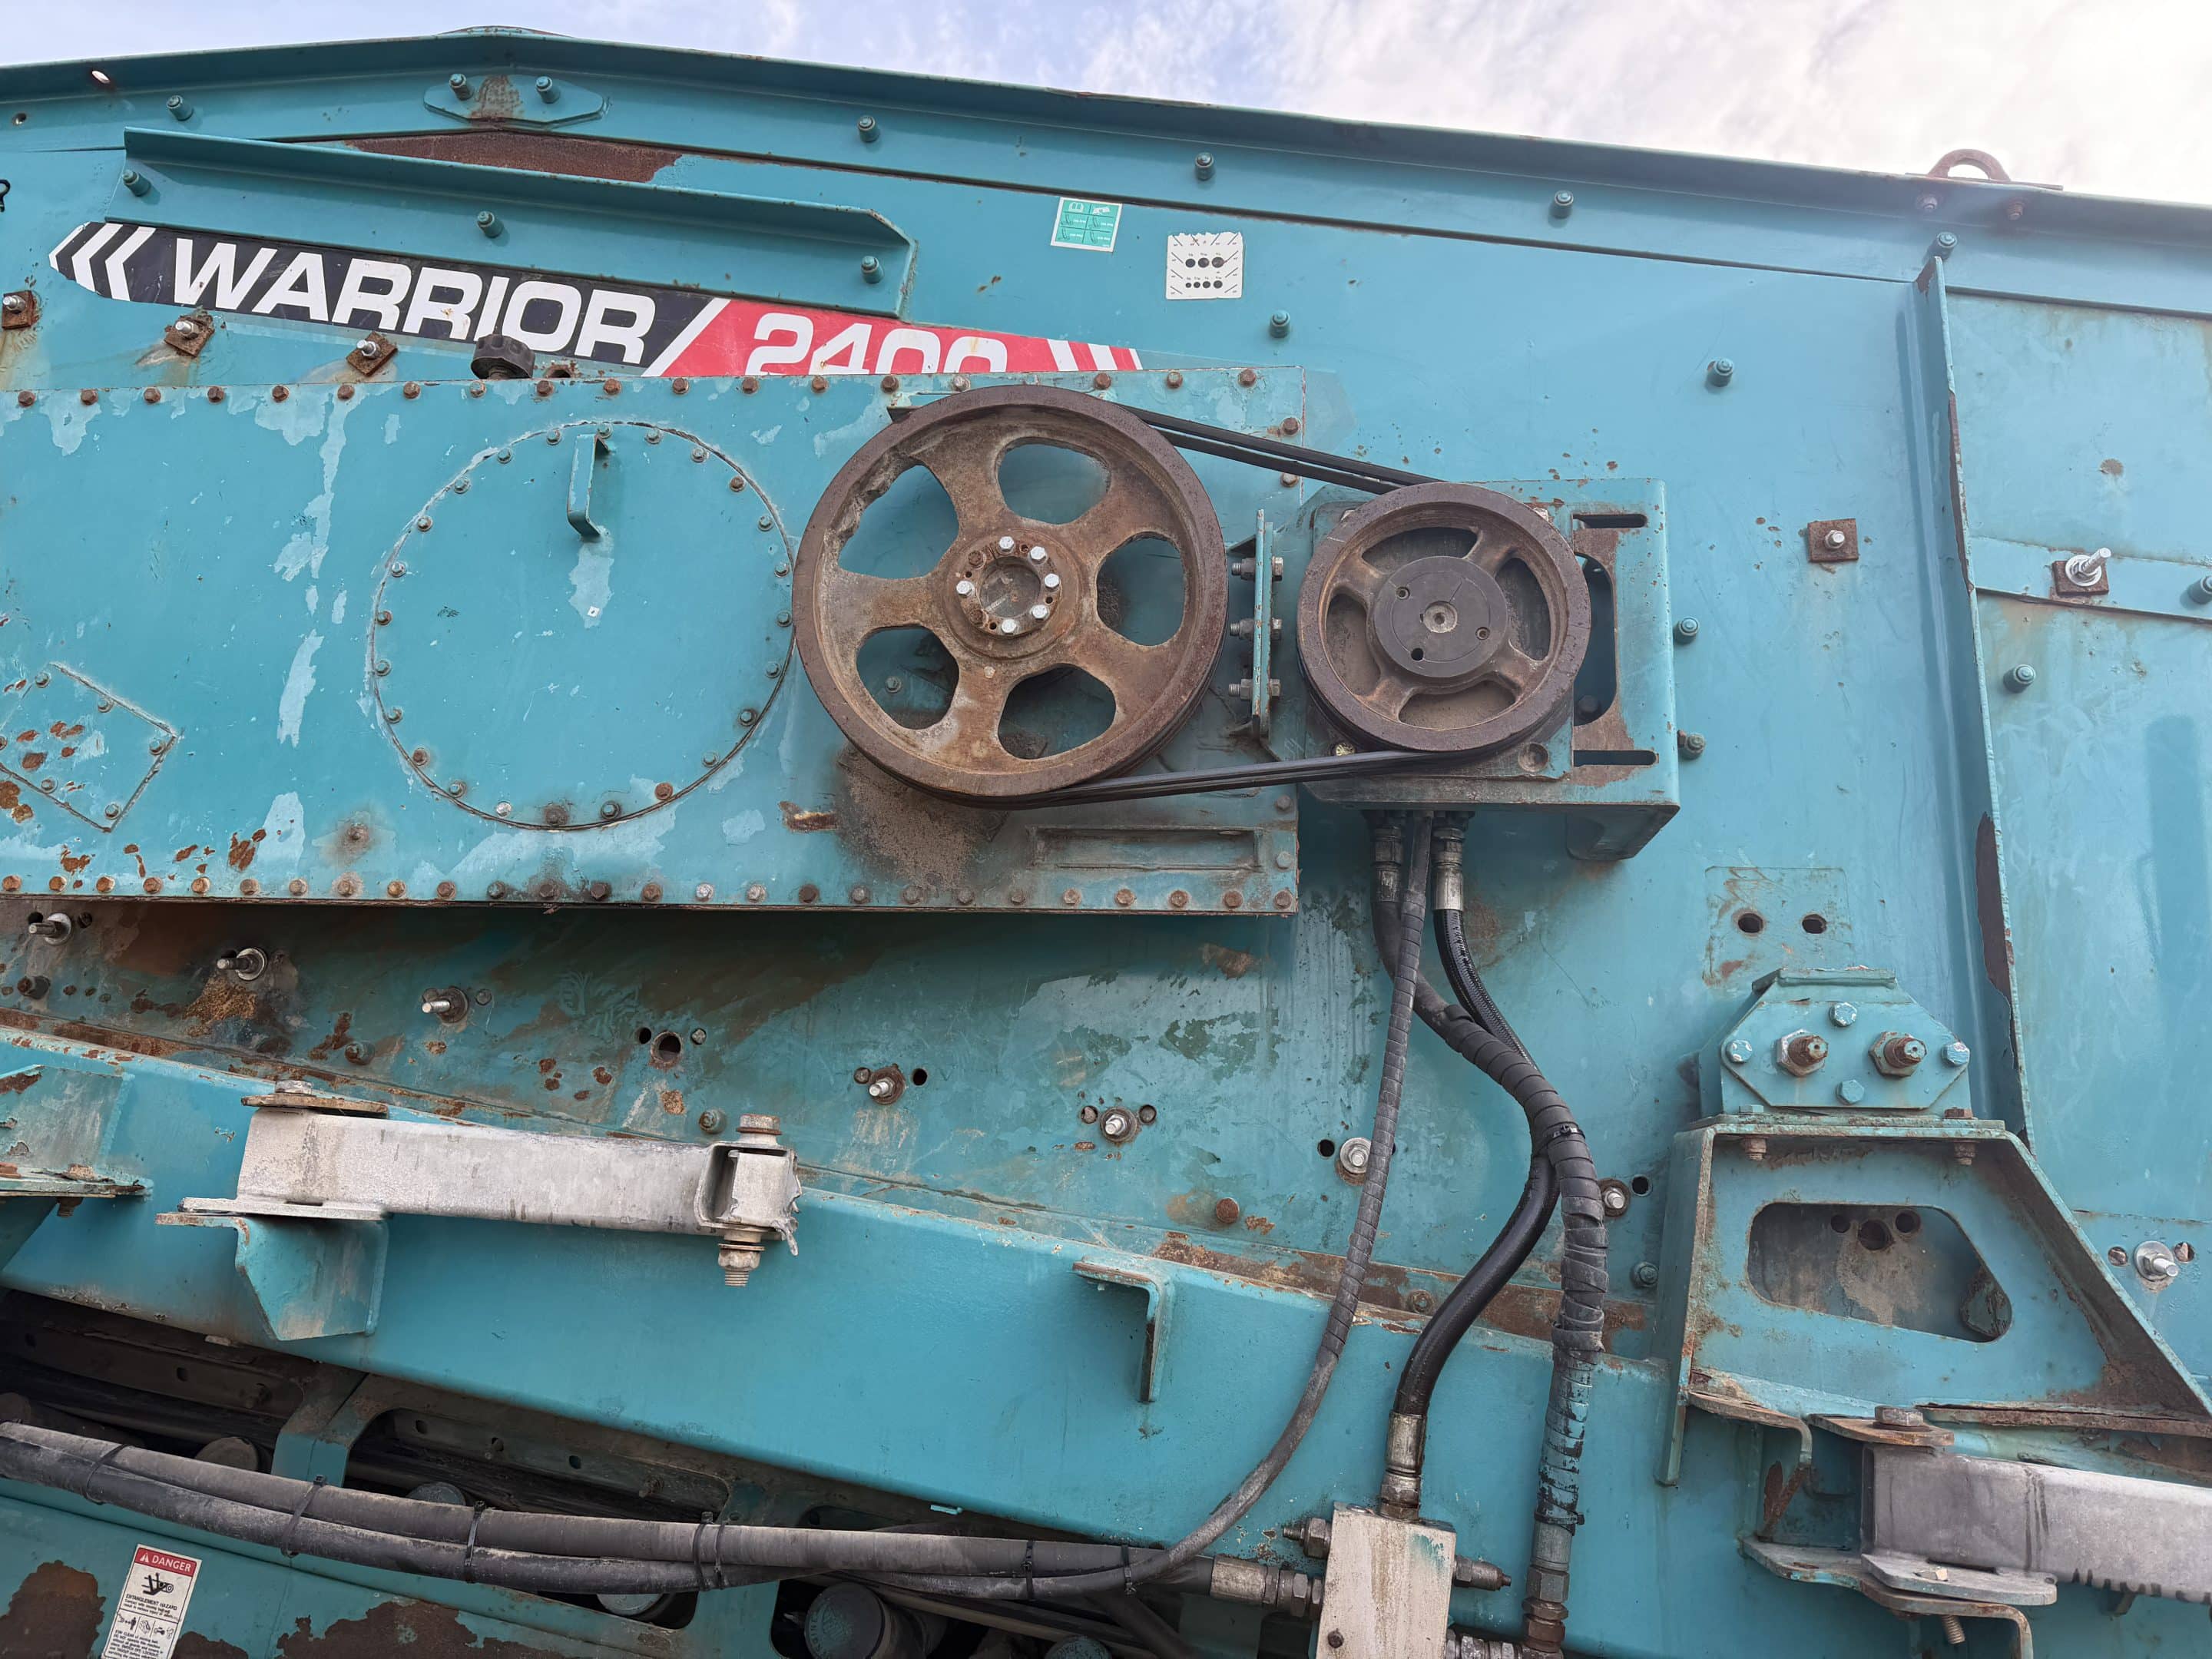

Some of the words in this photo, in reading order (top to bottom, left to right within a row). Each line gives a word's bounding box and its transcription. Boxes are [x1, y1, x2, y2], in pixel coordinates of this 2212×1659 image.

[174, 238, 656, 364] WARRIOR
[152, 1555, 191, 1573] DANGER
[159, 1602, 177, 1611] HAZARD
